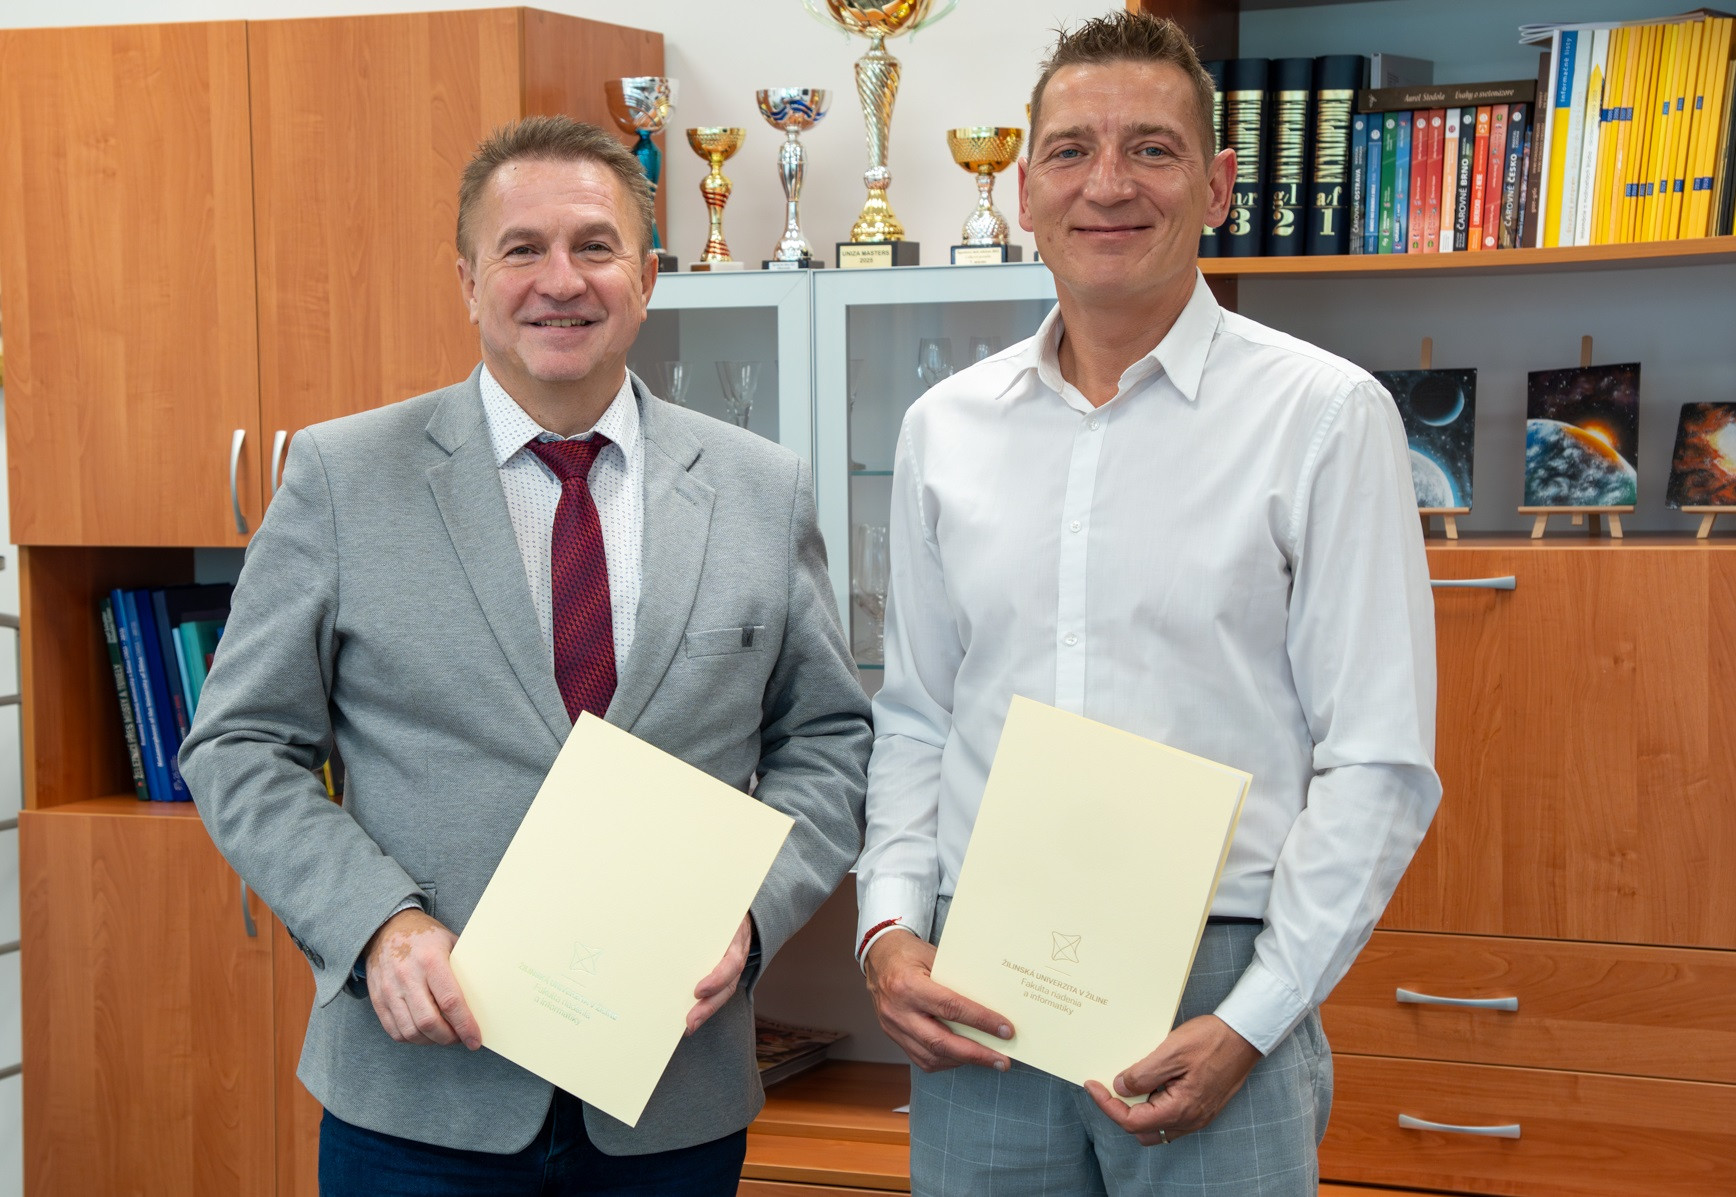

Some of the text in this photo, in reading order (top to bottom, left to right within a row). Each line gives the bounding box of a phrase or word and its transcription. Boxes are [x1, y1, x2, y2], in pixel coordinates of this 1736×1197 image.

[1564, 37, 1572, 55] listy
[1423, 92, 1445, 101] Stodola
[1460, 158, 1469, 186] BRNO
[1507, 153, 1517, 183] ČESKO
[1316, 186, 1342, 206] a/f
[1456, 187, 1467, 230] ČAROVNÉ
[1504, 185, 1515, 226] ČAROVNÉ
[1229, 208, 1251, 236] 3
[1273, 209, 1295, 236] 2
[1320, 208, 1335, 236] 1
[1001, 959, 1109, 1006] ŽILINSKÁ UNIVERZITA V ŽILINE
[1021, 977, 1049, 996] Fakulta
[1030, 993, 1075, 1016] informatiky
